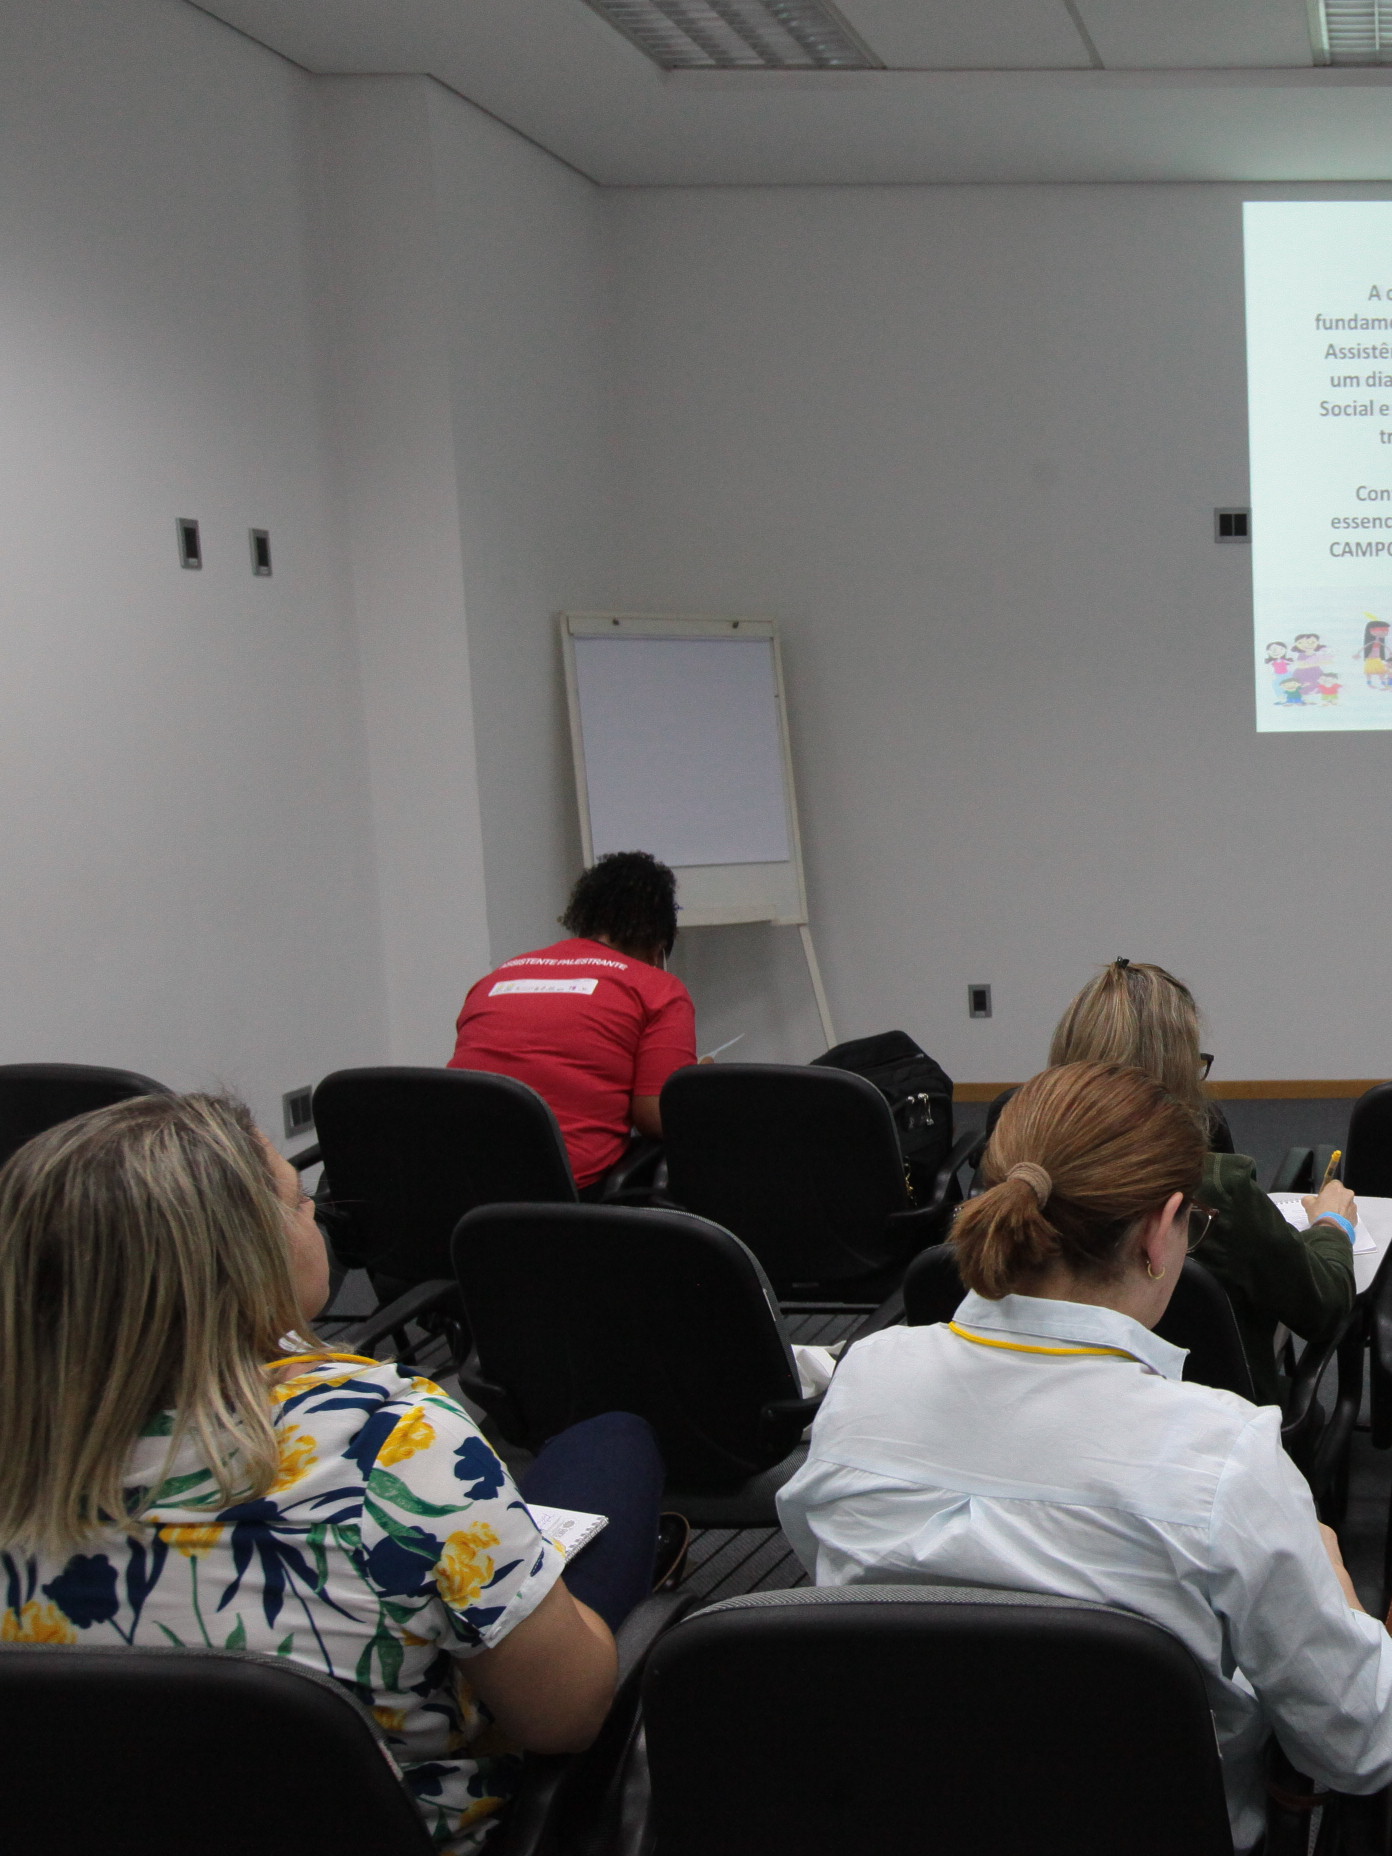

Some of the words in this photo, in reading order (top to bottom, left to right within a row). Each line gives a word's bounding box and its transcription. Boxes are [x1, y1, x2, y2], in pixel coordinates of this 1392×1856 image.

[1368, 284, 1382, 301] A
[1330, 375, 1361, 388] um
[1319, 399, 1374, 417] Social
[1378, 404, 1390, 416] e
[557, 957, 628, 971] PALESTRANTE
